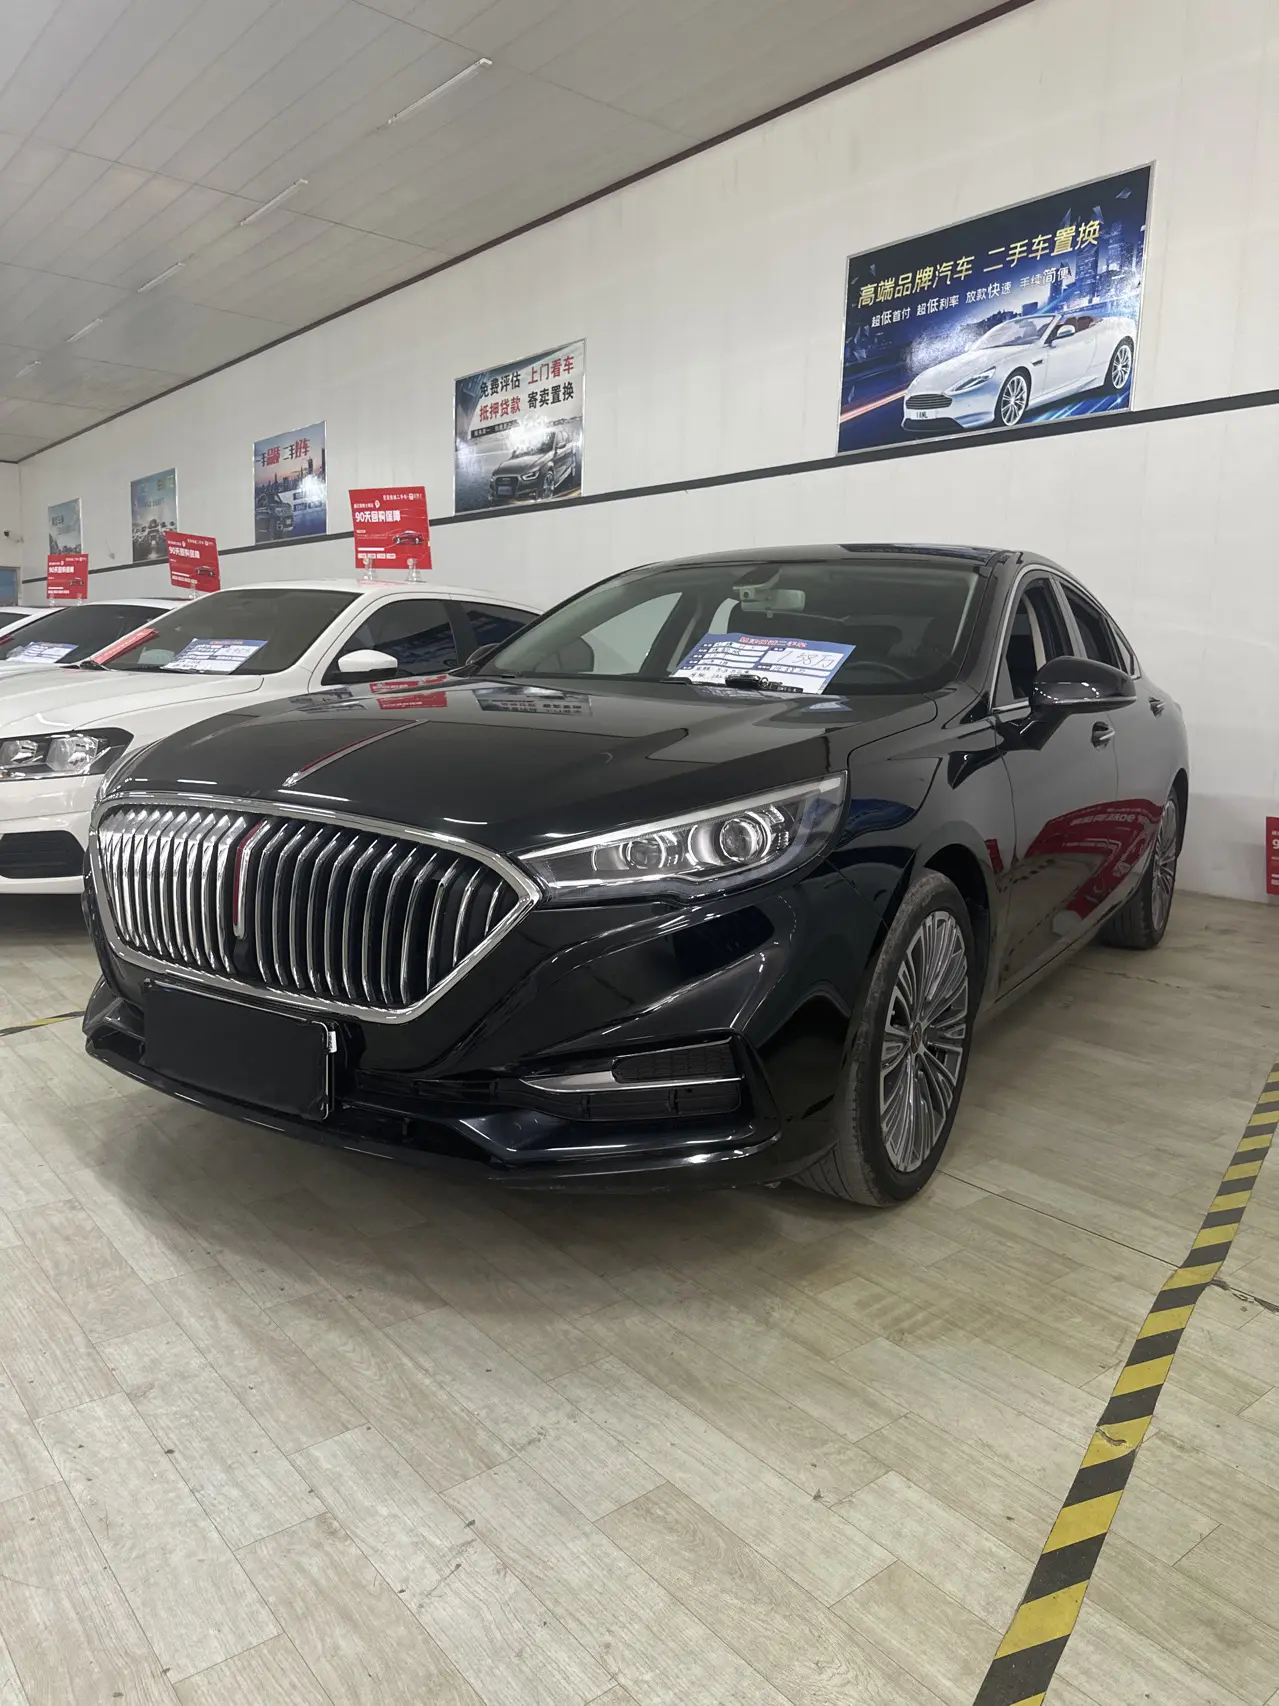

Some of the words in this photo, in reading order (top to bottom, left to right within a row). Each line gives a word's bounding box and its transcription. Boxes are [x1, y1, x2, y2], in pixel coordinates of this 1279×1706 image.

[857, 255, 975, 309] 高端品牌汽车
[983, 220, 1100, 273] 二手车置换
[871, 307, 911, 328] 超低首付
[916, 295, 960, 317] 超低利率
[966, 281, 1012, 303] 放款快速
[479, 371, 521, 399] 免费评估
[528, 356, 574, 385] 上门看车
[479, 396, 521, 422] 抵押贷款
[527, 382, 574, 409] 寄卖置换
